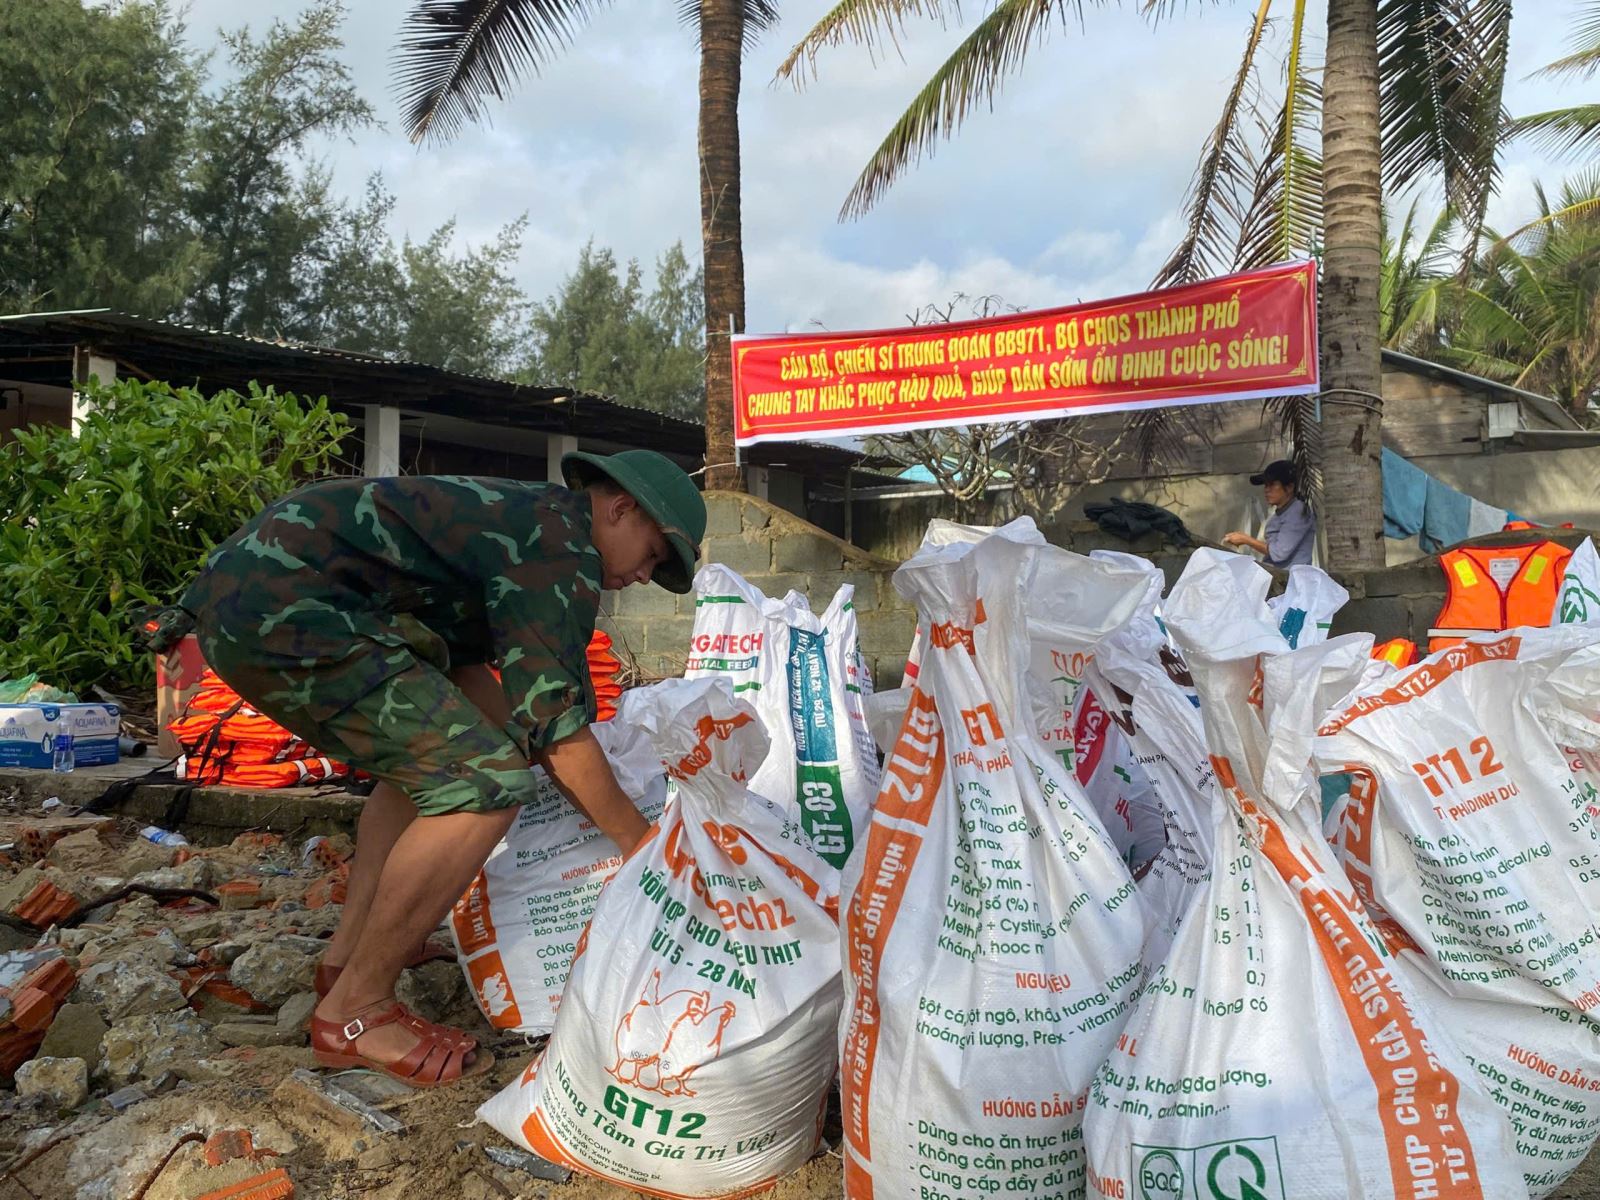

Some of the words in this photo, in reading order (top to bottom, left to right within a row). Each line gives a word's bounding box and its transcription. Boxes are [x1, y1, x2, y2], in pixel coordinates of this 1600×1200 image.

[781, 355, 807, 381] CÁN
[812, 349, 833, 380] BỘ,
[835, 345, 875, 375] CHIẾN
[879, 341, 895, 371] SĨ
[897, 339, 944, 368] TRUNG
[995, 326, 1052, 357] BB971,
[1056, 318, 1079, 354] BỘ
[1135, 303, 1196, 340] THÀNH
[1201, 289, 1241, 331] PHỐ
[748, 390, 791, 418] CHUNG
[795, 388, 815, 413] TAY
[819, 377, 854, 411] KHẮC
[858, 380, 895, 411] PHỤC
[899, 374, 930, 408] HẬU
[933, 365, 966, 399] QUẢ,
[971, 364, 1006, 396] GIÚP
[1010, 359, 1046, 393] DÂN
[1049, 354, 1087, 389] SỚM
[1092, 346, 1116, 384] ỔN
[1121, 350, 1165, 386] ĐỊNH
[1170, 339, 1221, 378] CUỘC
[1227, 328, 1289, 370] SỐNG!
[880, 706, 941, 803] GT12
[802, 781, 846, 854] GT-03
[991, 804, 1017, 816] min
[980, 817, 1004, 834] trao
[973, 838, 1003, 851] max
[1438, 834, 1460, 851] (%)
[876, 842, 906, 889] HỖN
[992, 857, 1022, 870] max
[1444, 852, 1468, 868] thô
[996, 878, 1022, 891] min
[1442, 870, 1484, 885] lượng
[527, 893, 551, 907] Dùng
[553, 889, 572, 901] cho
[573, 885, 586, 897] ăn
[529, 905, 560, 918] Không
[561, 895, 580, 909] cần
[985, 895, 1002, 910] số
[1006, 897, 1029, 912] (%)
[1422, 894, 1443, 908] Ca
[1464, 909, 1490, 920] min
[531, 914, 558, 928] Cung
[862, 893, 888, 939] HỢP
[533, 926, 553, 938] Bảo
[686, 915, 721, 947] CHO
[761, 940, 802, 965] THỊT
[1485, 924, 1510, 938] (%)
[1579, 929, 1594, 947] số
[536, 942, 576, 959] CÔNG
[990, 941, 1031, 955] hooc
[1507, 940, 1524, 954] số
[543, 959, 560, 973] Địa
[697, 959, 726, 983] 28
[1442, 968, 1490, 984] Kháng
[1491, 963, 1521, 978] sinh
[1345, 954, 1390, 1020] SIÊU
[919, 996, 941, 1016] Bột
[985, 1006, 1020, 1025] ngô,
[1062, 992, 1110, 1016] tương,
[1250, 996, 1268, 1012] có
[979, 1029, 1029, 1047] lượng,
[1078, 1002, 1129, 1034] vitamin,
[1370, 1020, 1411, 1062] GÀ
[1507, 1043, 1559, 1079] HƯỚNG
[1558, 1067, 1588, 1090] DẪN
[1194, 1076, 1216, 1091] đa
[1478, 1061, 1509, 1084] cho
[1510, 1078, 1532, 1096] ăn
[1532, 1086, 1561, 1106] trực
[1562, 1100, 1586, 1114] tiếp
[983, 1096, 1036, 1118] HƯỚNG
[1041, 1093, 1073, 1118] DẪN
[1393, 1067, 1420, 1126] CHO
[555, 1060, 588, 1118] Nâng
[592, 1109, 636, 1149] Tầm
[644, 1139, 684, 1160] Giá
[695, 1145, 726, 1162] Trị
[736, 1130, 778, 1154] Việt
[603, 1085, 707, 1140] GT12
[1432, 1103, 1454, 1136] 15
[1510, 1101, 1540, 1119] pha
[1542, 1111, 1567, 1127] trộn
[1569, 1118, 1588, 1130] với
[918, 1120, 958, 1146] Dùng
[962, 1133, 994, 1148] cho
[1000, 1130, 1021, 1147] ăn
[1025, 1134, 1057, 1150] trực
[1529, 1126, 1548, 1141] đủ
[1548, 1133, 1577, 1144] nước
[918, 1141, 968, 1170] Không
[973, 1149, 1005, 1171] cần
[1011, 1154, 1044, 1173] pha
[1048, 1146, 1078, 1166] trộn
[1516, 1140, 1539, 1157] khô
[1405, 1135, 1439, 1200] HỢP
[1442, 1144, 1470, 1186] TỪ
[919, 1164, 962, 1190] Cung
[966, 1174, 1000, 1193] cấp
[1005, 1173, 1038, 1192] đầy
[1042, 1168, 1064, 1187] đủ
[1143, 1170, 1181, 1193] BQC
